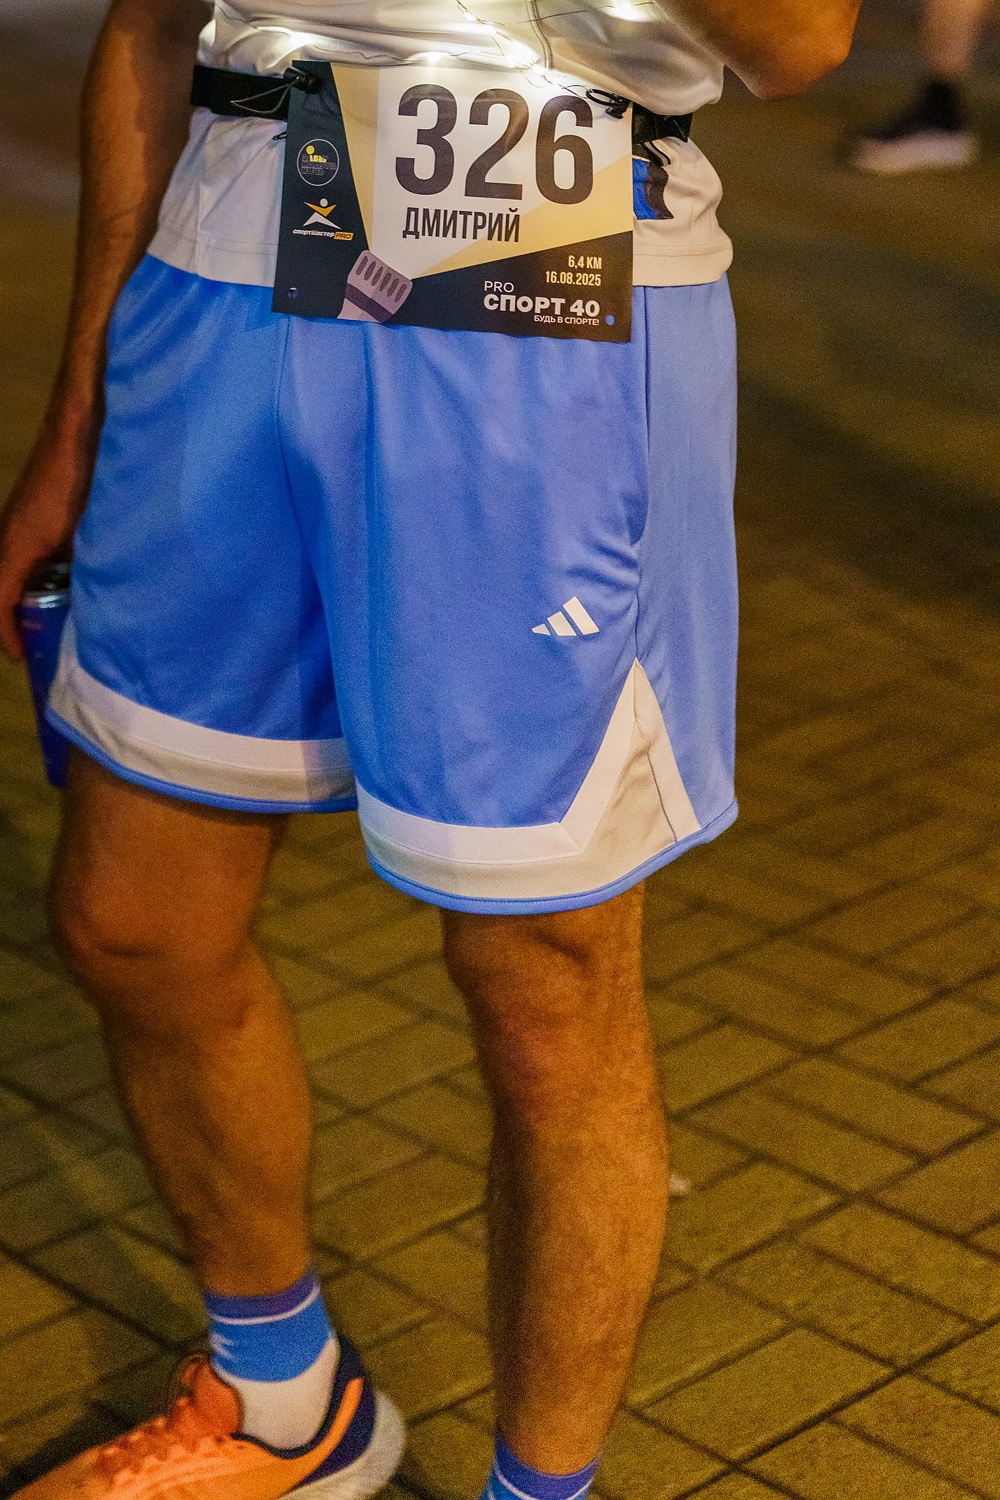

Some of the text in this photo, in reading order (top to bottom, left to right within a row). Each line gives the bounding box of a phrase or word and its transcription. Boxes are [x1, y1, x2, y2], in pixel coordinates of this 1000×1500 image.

[395, 83, 594, 205] 326
[402, 207, 520, 243] ДМИТРИЙ
[335, 232, 352, 240] PRO
[568, 255, 602, 269] 6,4 КМ
[546, 271, 601, 286] 16.08.2025
[484, 281, 514, 293] PRO
[483, 294, 600, 317] СПОРТ 40
[534, 315, 556, 323] БУДЬ
